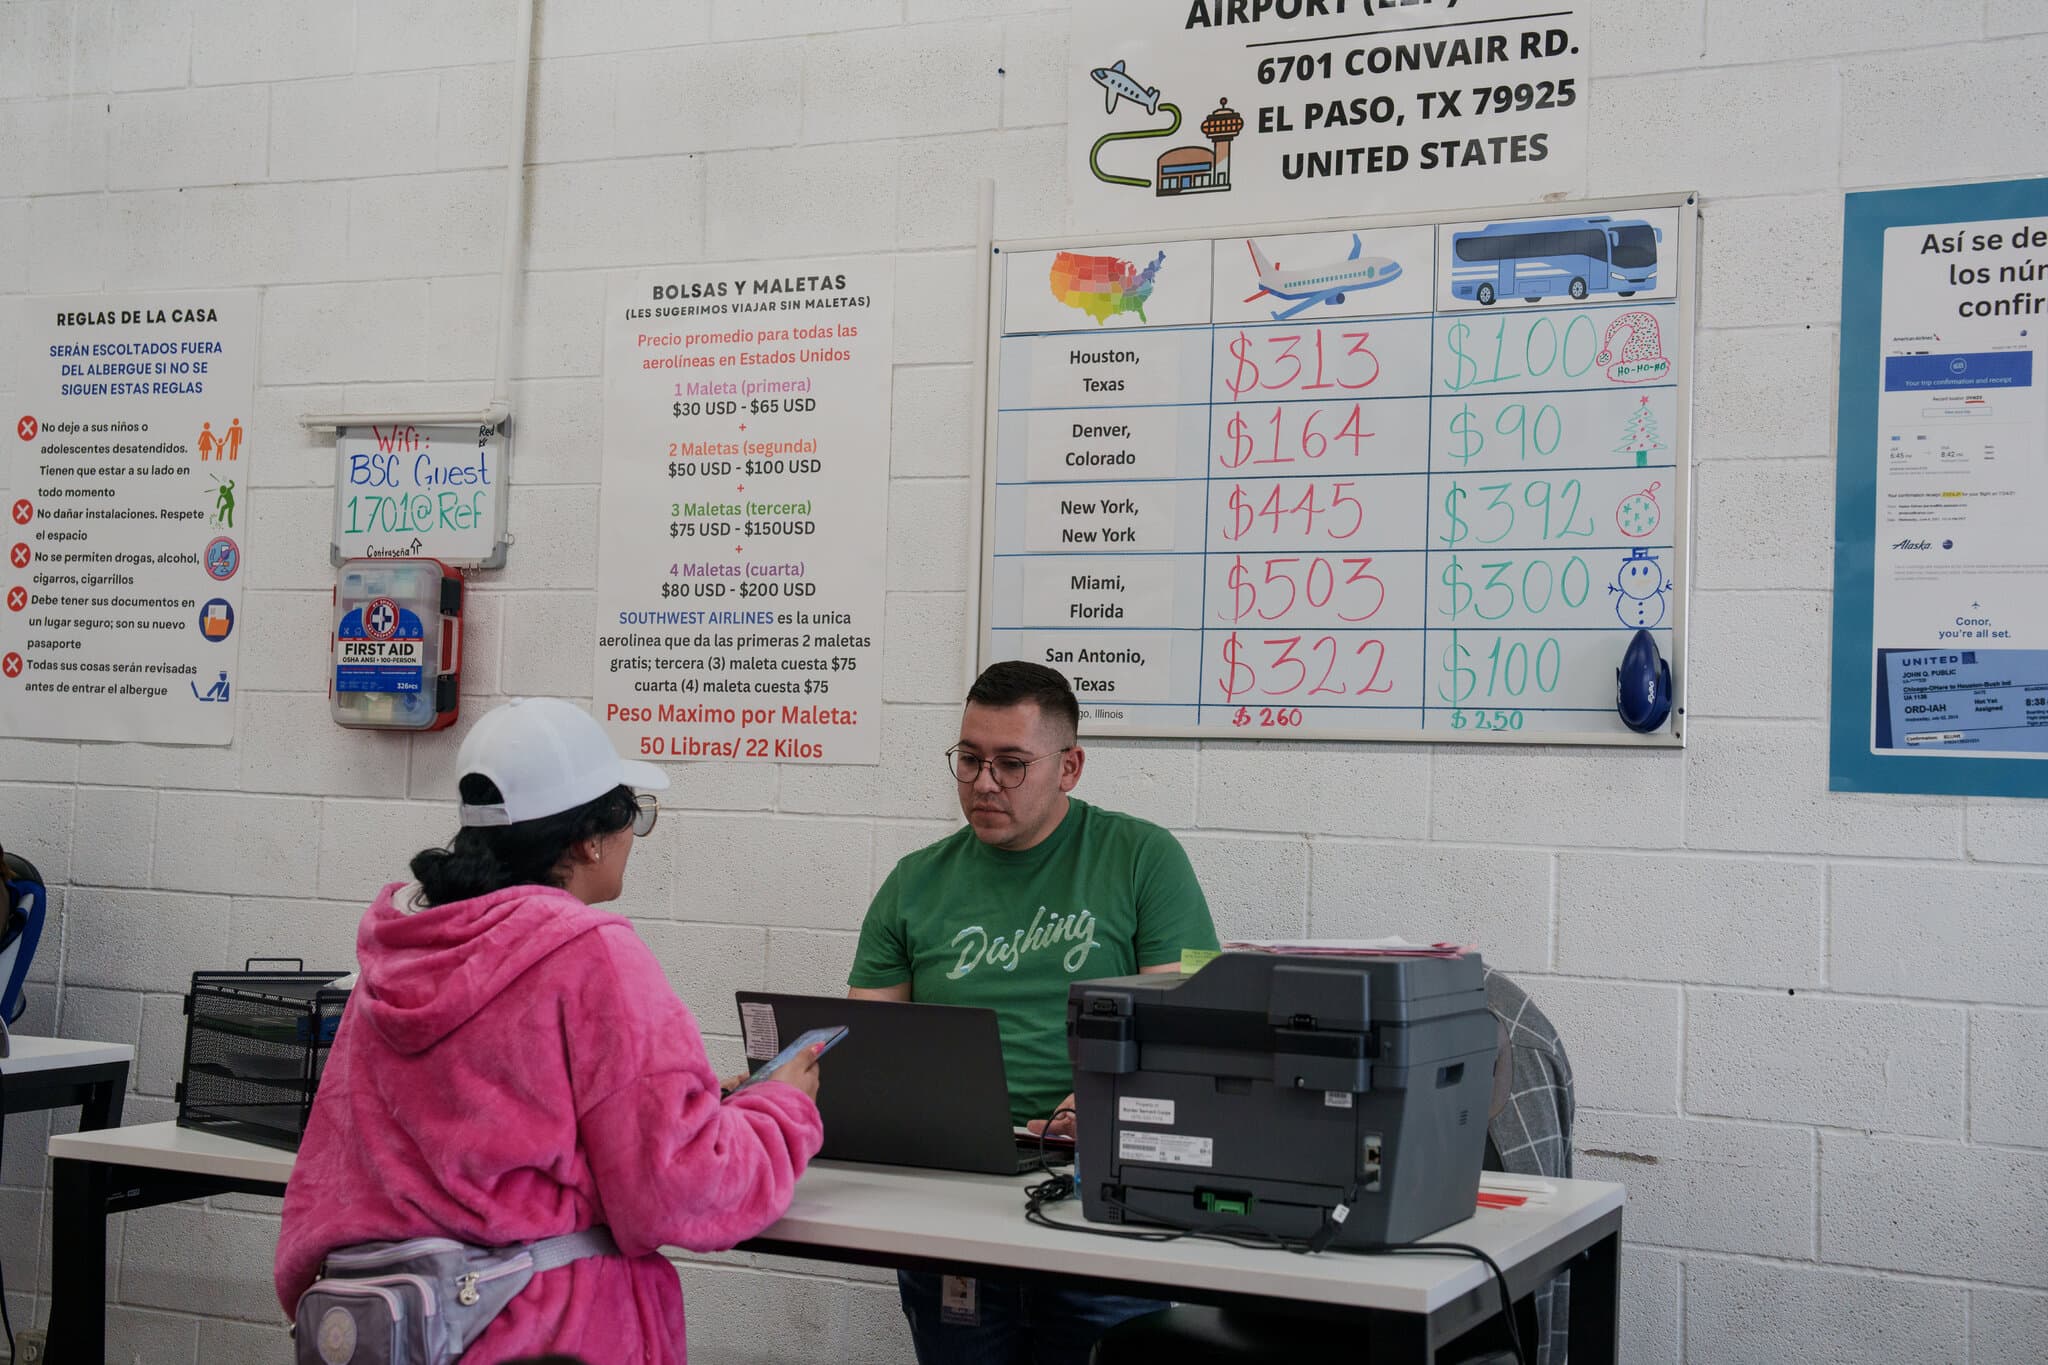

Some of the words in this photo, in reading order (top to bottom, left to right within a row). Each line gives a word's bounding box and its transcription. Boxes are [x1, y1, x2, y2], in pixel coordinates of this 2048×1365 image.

[1257, 53, 1332, 84] 6701
[1345, 36, 1509, 75] CONVAIR
[1520, 29, 1579, 59] RD.
[1258, 106, 1293, 133] EL
[1305, 96, 1405, 129] PASO,
[1417, 90, 1462, 119] TX
[1473, 79, 1576, 114] 79925
[1281, 144, 1409, 181] UNITED
[1418, 132, 1550, 170] STATES
[1921, 231, 1966, 254] Así
[1972, 234, 2003, 251] se
[2012, 226, 2048, 248] de
[1950, 264, 1990, 285] los
[652, 282, 728, 301] BOLSAS
[734, 280, 747, 296] Y
[752, 274, 847, 295] MALETAS
[626, 308, 652, 320] (LES
[655, 305, 728, 317] SUGERIMOS
[732, 302, 776, 313] VIAJAR
[780, 300, 801, 310] SIN
[805, 296, 871, 308] MALETAS)
[57, 311, 116, 326] REGLAS
[121, 310, 141, 324] DE
[146, 309, 166, 323] LA
[171, 308, 218, 322] CASA
[638, 333, 682, 347] Precio
[685, 329, 754, 347] promedio
[757, 330, 790, 344] para
[791, 325, 833, 339] todas
[837, 324, 858, 337] las
[50, 343, 89, 357] SERÁN
[93, 342, 178, 356] ESCOLTADOS
[181, 341, 223, 354] FUERA
[1070, 350, 1140, 364] Houston,
[1442, 315, 1598, 393] $100
[642, 353, 716, 370] aerolíneas
[719, 355, 737, 367] en
[740, 351, 796, 366] Estados
[799, 348, 850, 364] Unidos
[1223, 327, 1382, 401] $313
[62, 364, 84, 376] DEL
[87, 363, 151, 375] ALBERGUE
[155, 363, 166, 374] SI
[170, 362, 189, 374] NO
[192, 362, 208, 373] SE
[61, 383, 107, 395] SIGUEN
[110, 382, 149, 395] ESTAS
[152, 382, 203, 394] REGLAS
[675, 383, 683, 398] 1
[687, 381, 738, 395] Maleta
[741, 377, 811, 396] (primera)
[1083, 378, 1125, 392] Texas
[373, 424, 430, 454] Wifi:
[479, 425, 495, 437] Red
[1072, 424, 1131, 438] Denver,
[1218, 402, 1375, 468] $164
[1448, 404, 1562, 465] $90
[41, 443, 110, 455] adolescentes
[112, 443, 188, 454] desatendidos.
[1065, 451, 1136, 466] Colorado
[350, 454, 400, 488] BSC
[414, 451, 491, 490] Guest
[37, 509, 52, 519] No
[53, 508, 84, 519] dañar
[86, 508, 158, 519] instalaciones.
[160, 509, 205, 521] Respete
[1061, 501, 1096, 515] New
[1100, 499, 1139, 515] York,
[1223, 483, 1363, 540] $445
[1440, 480, 1596, 548] $392
[36, 530, 45, 541] el
[47, 531, 88, 543] espacio
[1062, 529, 1098, 543] New
[1102, 527, 1136, 542] York
[366, 545, 410, 558] Contraseña
[1892, 538, 1931, 551] Alaska
[33, 575, 79, 587] cigarros,
[81, 574, 134, 587] cigarrillos
[1071, 576, 1125, 592] Miami,
[1440, 556, 1590, 620] $300
[1218, 556, 1385, 622] $503
[620, 612, 705, 624] SOUTHWEST
[709, 612, 774, 624] AIRLINES
[777, 614, 793, 624] es
[797, 611, 809, 624] la
[813, 611, 851, 624] unica
[1070, 603, 1124, 618] Florida
[1955, 616, 1992, 626] Conor,
[1939, 629, 1973, 640] you're
[1976, 629, 1989, 638] all
[1992, 630, 2011, 638] set.
[27, 639, 82, 651] pasaporte
[345, 643, 385, 656] FIRST
[388, 643, 414, 656] AID
[610, 656, 651, 672] gratis;
[655, 658, 704, 669] tercera
[708, 656, 726, 671] (3)
[730, 657, 778, 670] maleta
[781, 659, 828, 670] cuesta
[832, 656, 856, 672] $75
[1045, 648, 1074, 662] San
[1078, 649, 1145, 665] Antonio,
[1902, 655, 1959, 667] UNITED
[26, 660, 58, 671] Todas
[60, 662, 77, 672] sus
[80, 663, 110, 672] cosas
[112, 662, 142, 673] serán
[145, 663, 197, 675] revisadas
[1219, 633, 1393, 701] $322
[1439, 630, 1563, 704] $100
[25, 682, 54, 693] antes
[56, 682, 70, 692] de
[72, 684, 106, 694] entrar
[108, 684, 118, 695] el
[120, 684, 168, 697] albergue
[1073, 677, 1115, 691] Texas
[607, 704, 652, 722] Peso
[658, 704, 736, 723] Maximo
[742, 709, 776, 728] por
[782, 706, 857, 725] Maleta:
[1094, 708, 1125, 720] Illinois
[641, 737, 665, 754] 50
[671, 737, 741, 758] Libras/
[746, 738, 769, 757] 22
[775, 739, 823, 758] Kilos
[945, 905, 1101, 980] Dashing
